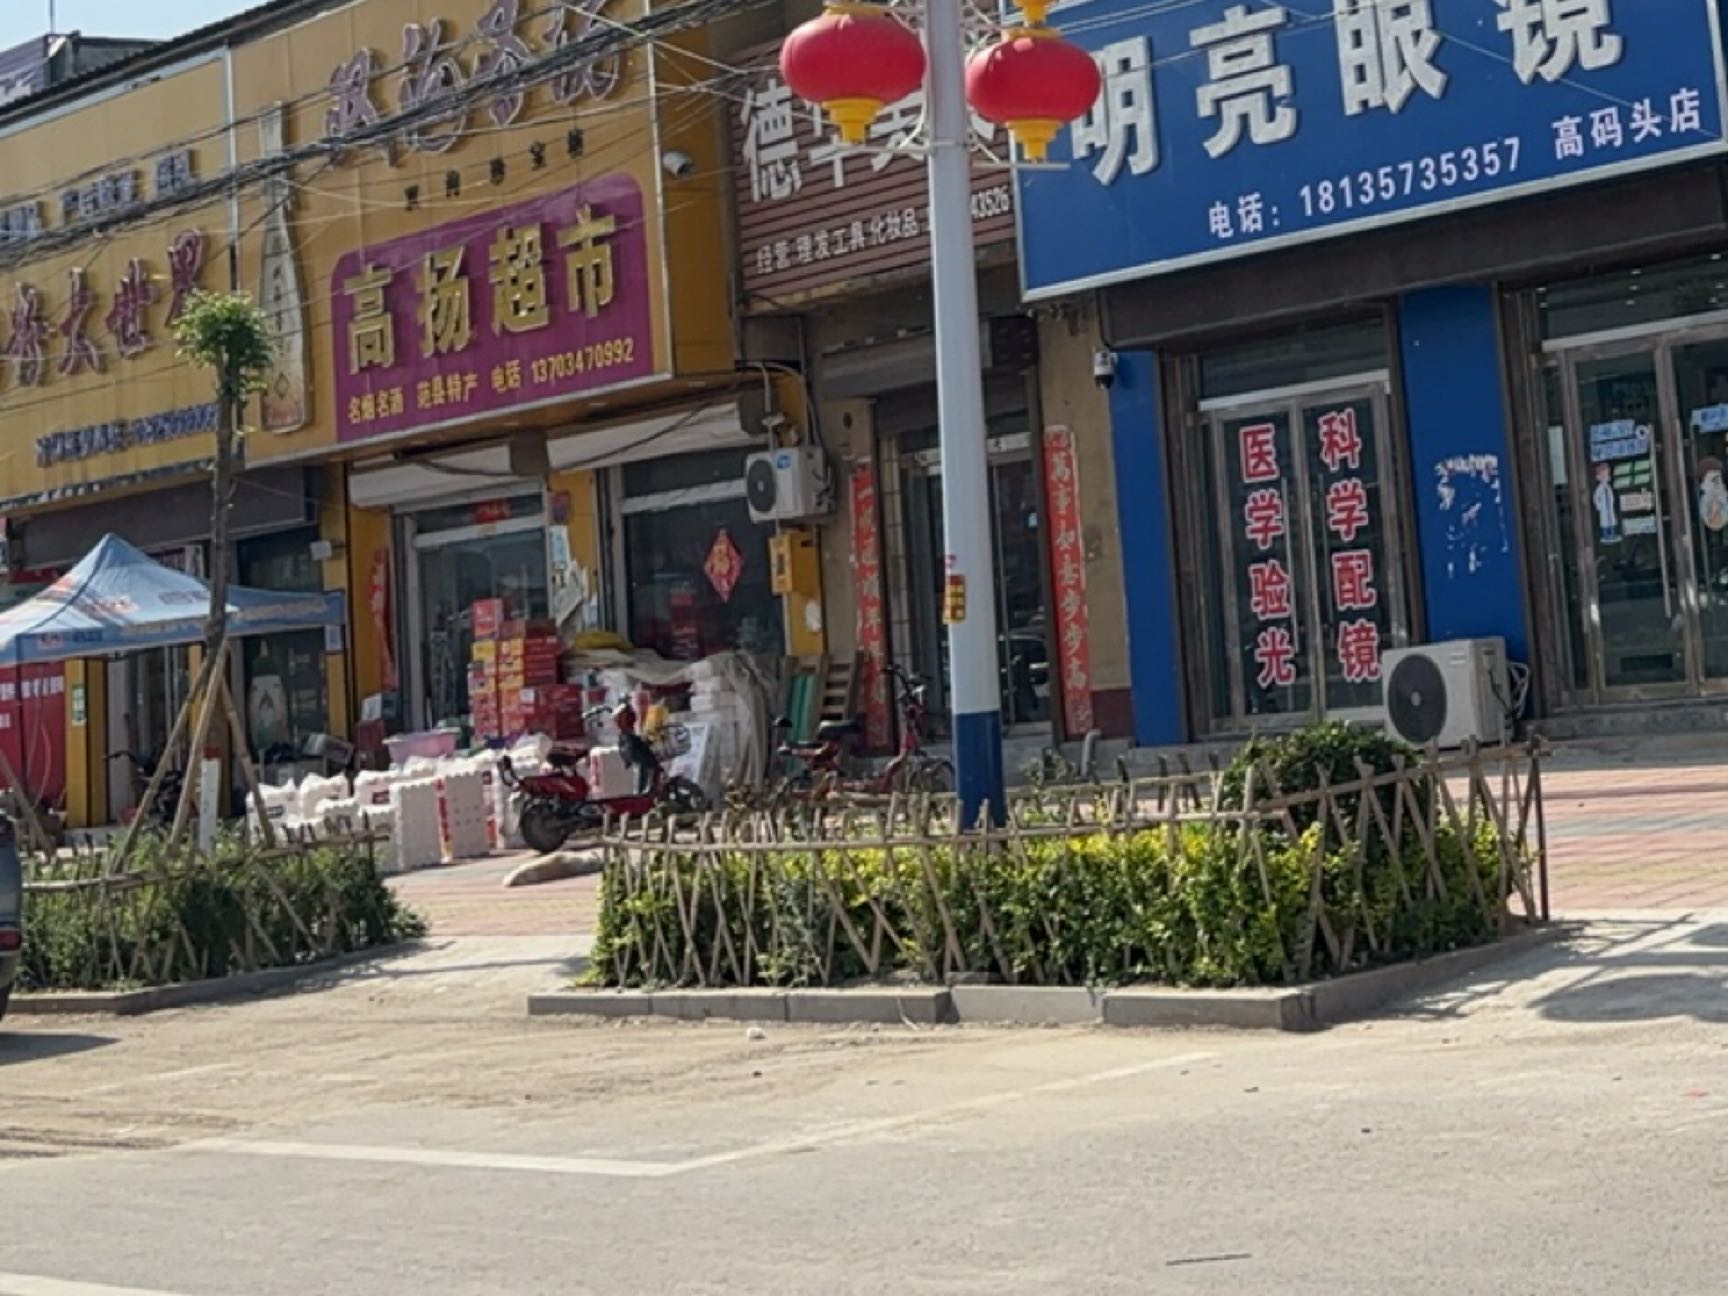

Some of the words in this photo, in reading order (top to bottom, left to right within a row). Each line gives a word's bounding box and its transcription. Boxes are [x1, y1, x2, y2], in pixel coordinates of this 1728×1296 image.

[1299, 136, 1522, 218] 18135735357
[1552, 87, 1701, 160] 高码头店
[344, 204, 615, 375] 高扬超市
[491, 358, 522, 394] 电话
[1238, 423, 1297, 688] 医学验光
[1317, 407, 1382, 683] 科学配镜
